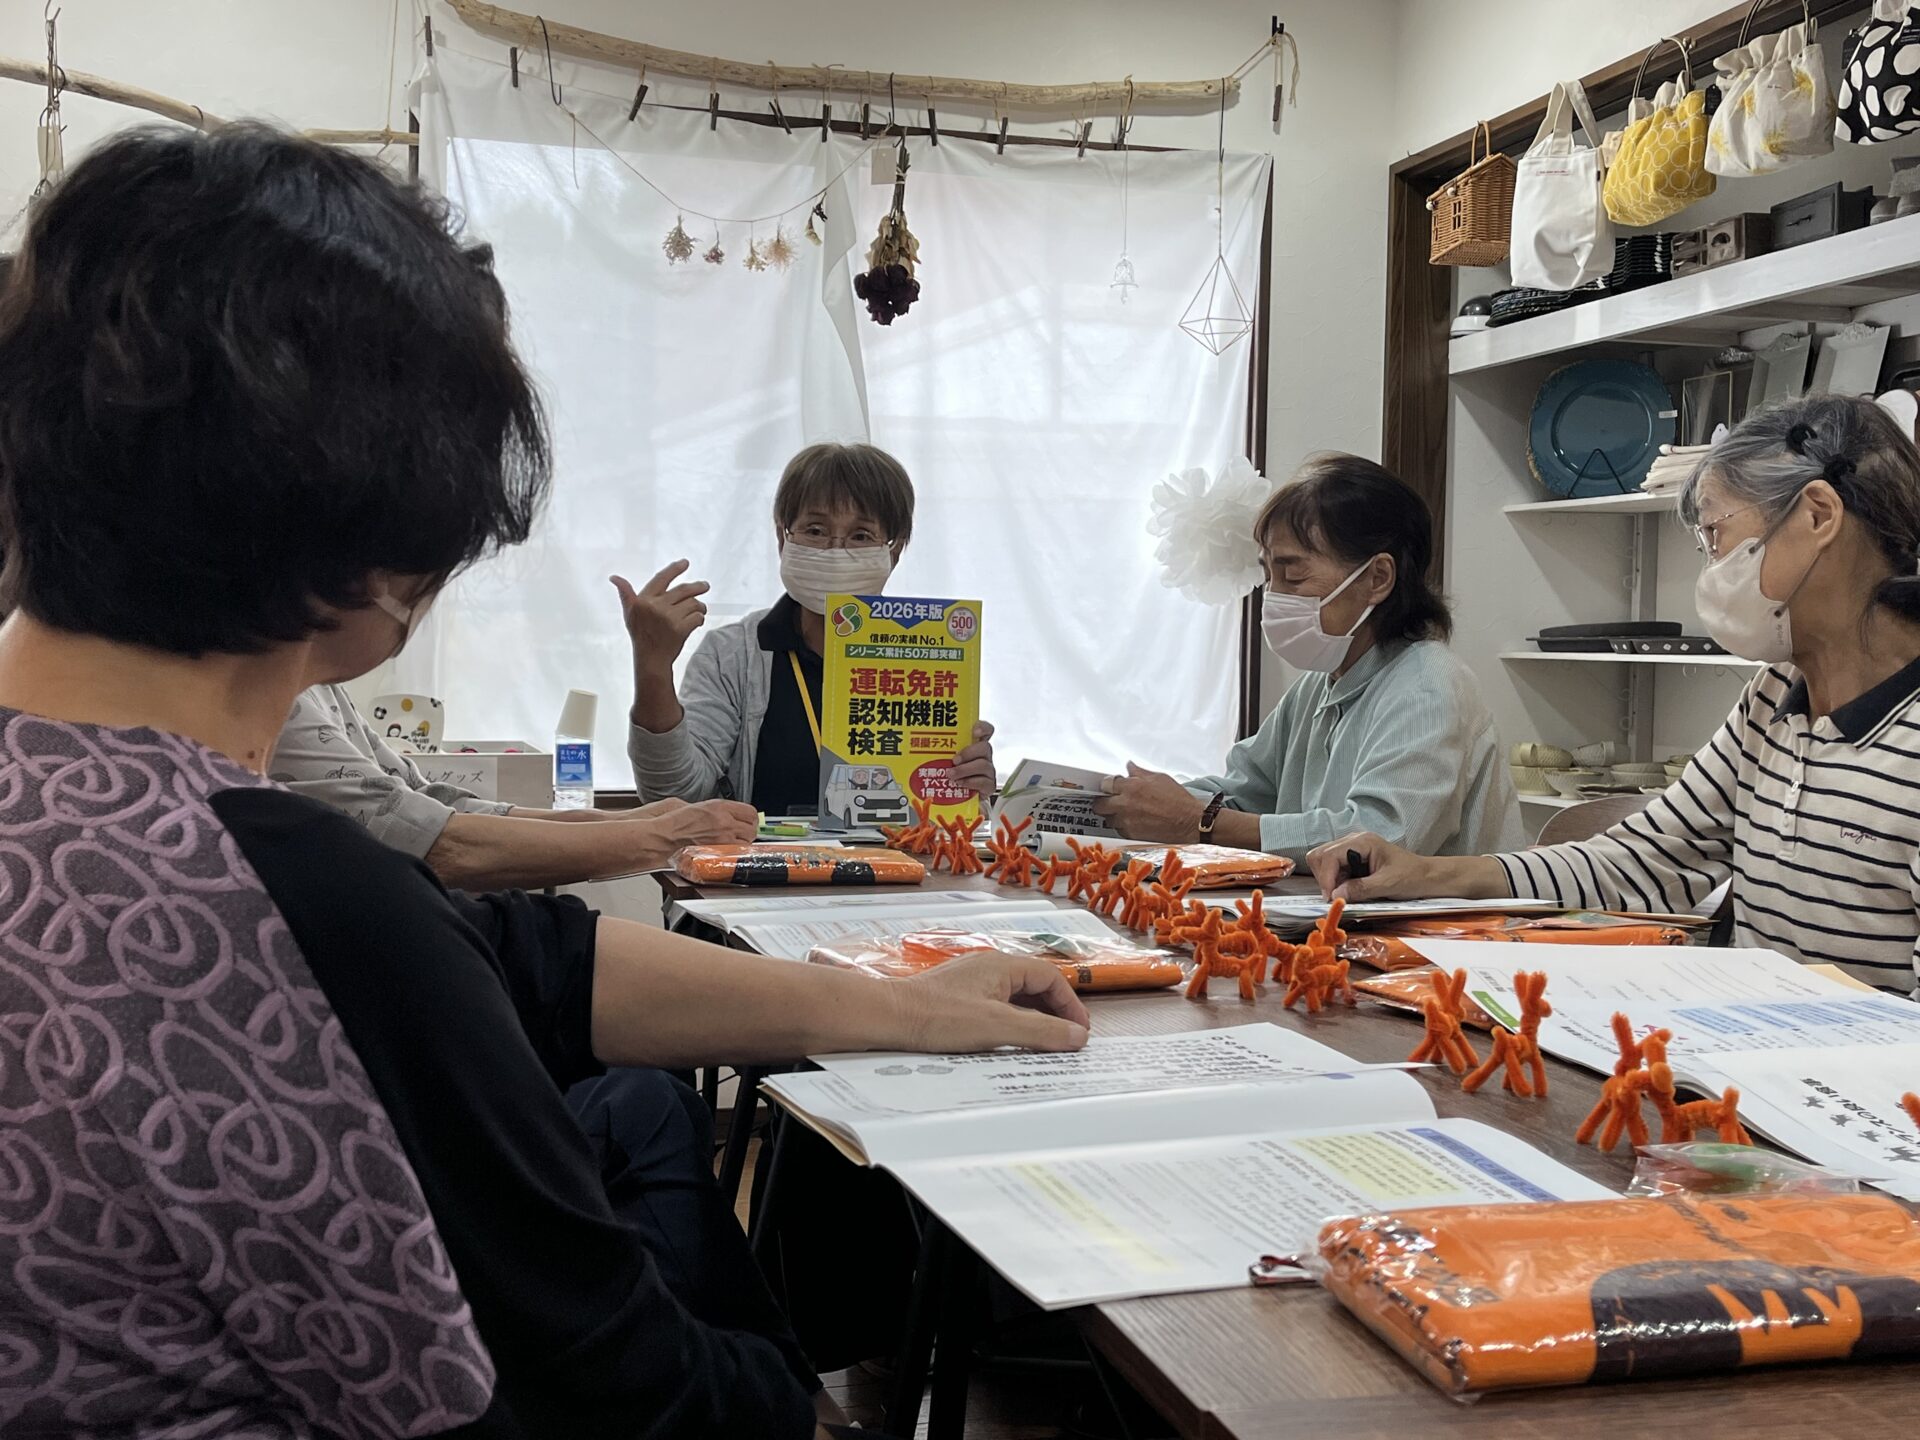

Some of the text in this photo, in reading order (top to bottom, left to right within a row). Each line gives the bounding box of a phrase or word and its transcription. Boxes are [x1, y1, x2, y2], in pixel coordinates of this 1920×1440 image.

[871, 601, 943, 620] 2026年版
[951, 616, 973, 629] 500
[850, 668, 959, 698] 運転免許
[848, 698, 958, 727] 認知機能
[847, 728, 903, 756] 検査
[910, 737, 957, 748] 模擬テスト
[918, 767, 951, 778] 実際の
